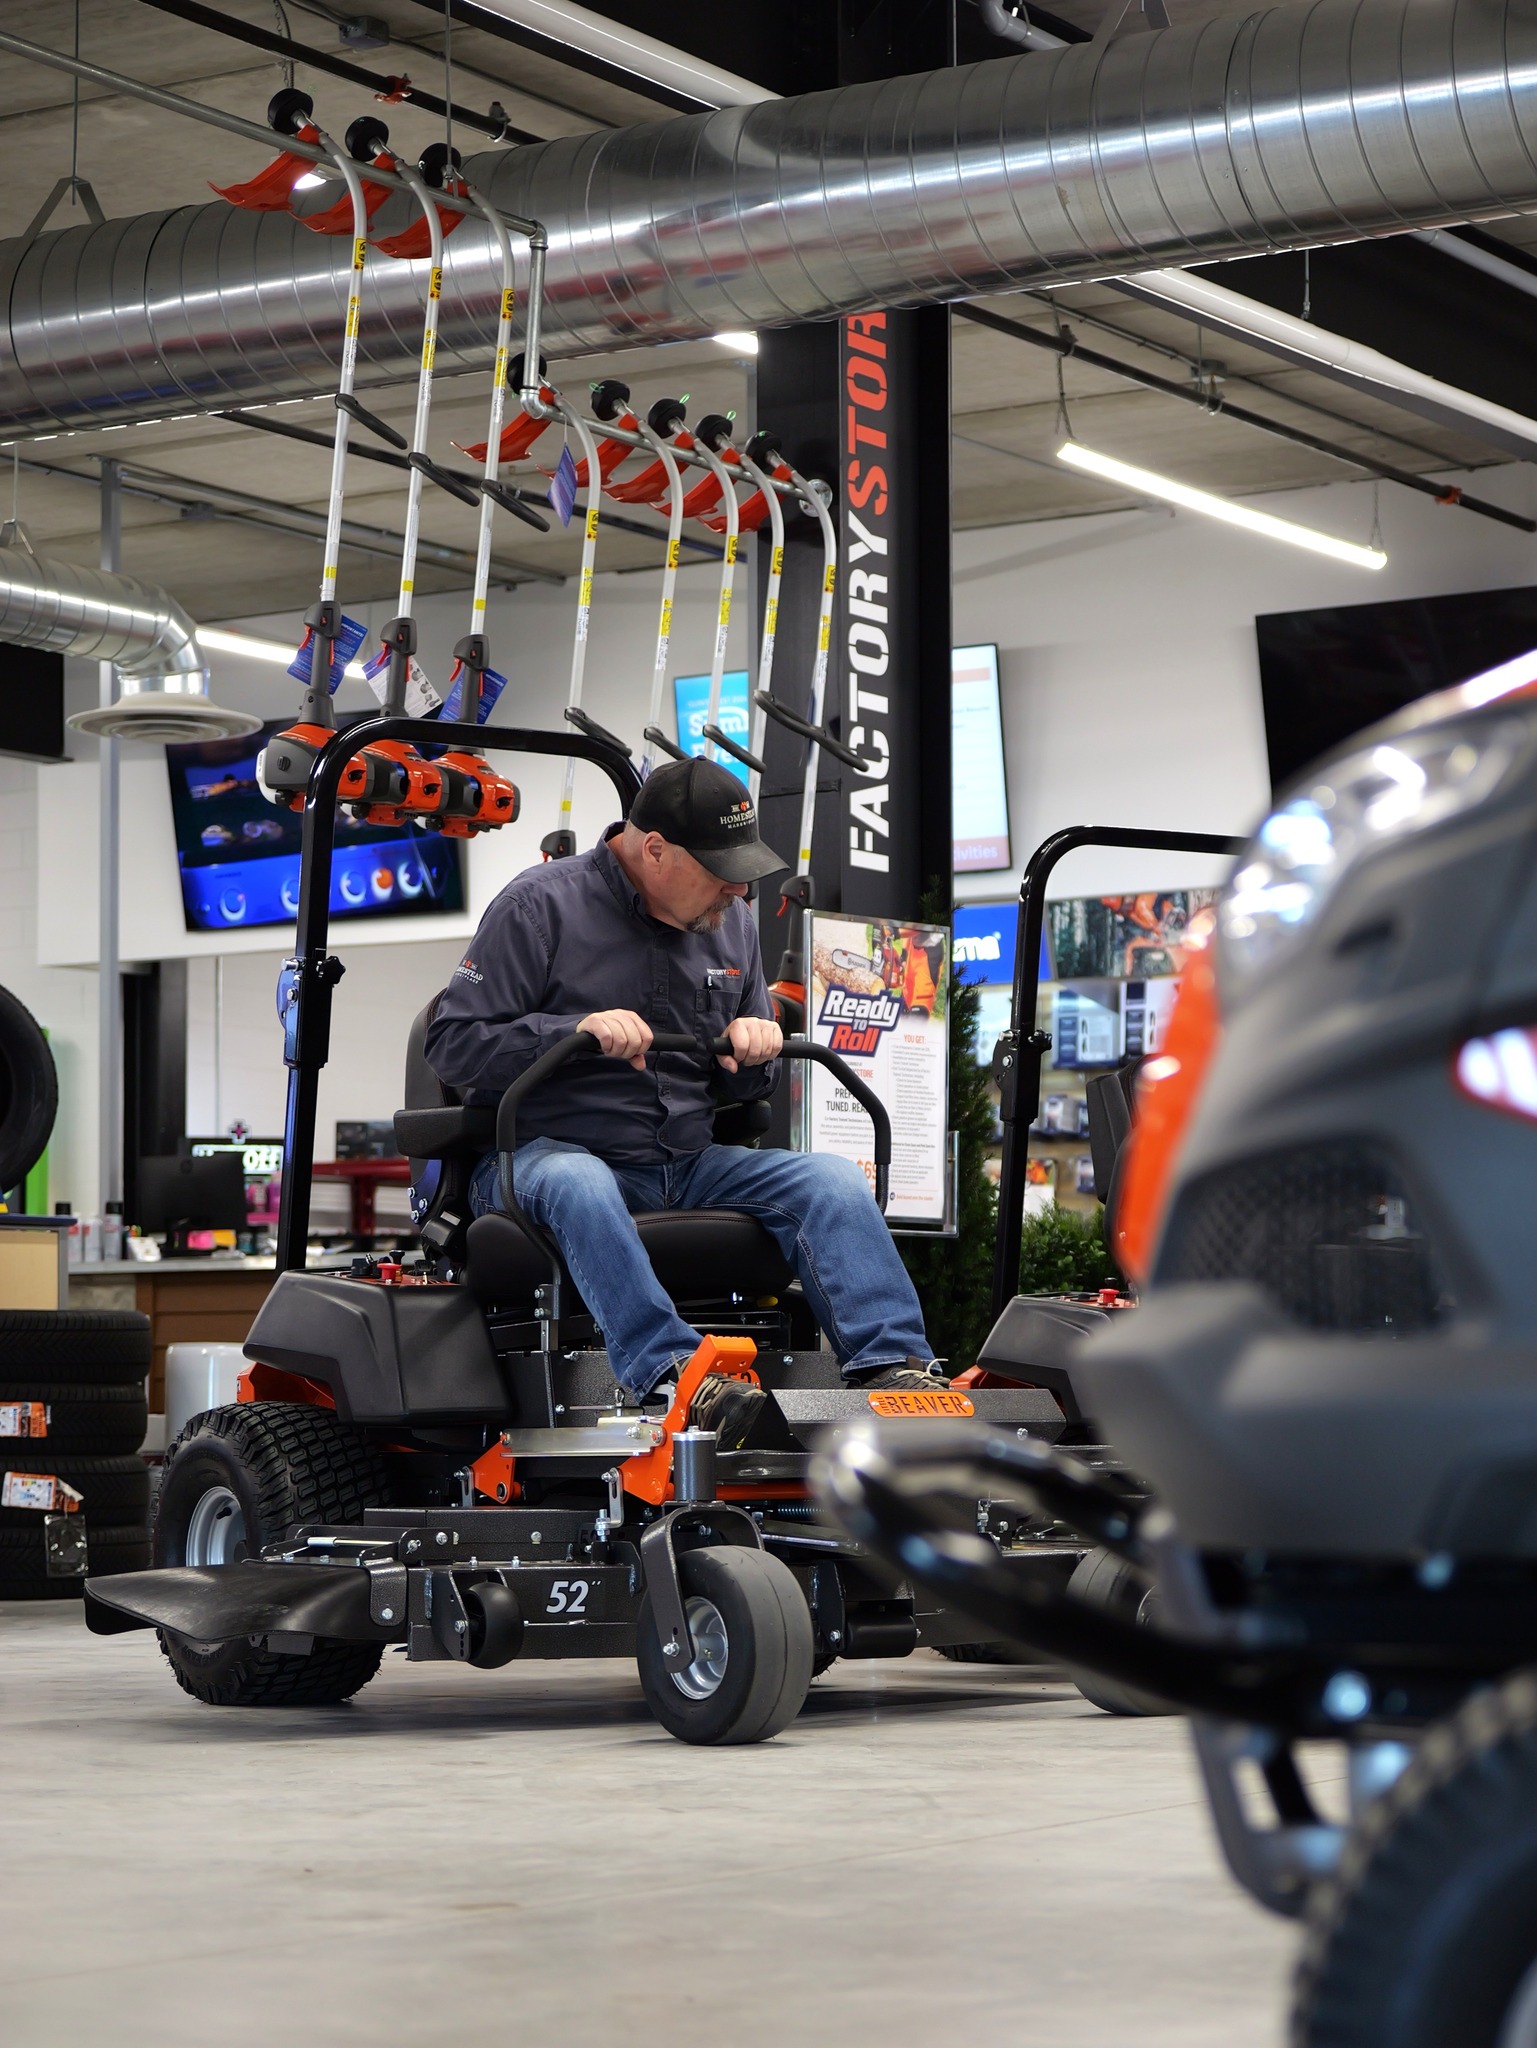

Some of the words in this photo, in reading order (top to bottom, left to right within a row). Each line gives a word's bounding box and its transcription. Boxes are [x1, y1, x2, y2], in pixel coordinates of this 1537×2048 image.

[823, 989, 900, 1028] Ready
[853, 1018, 868, 1031] TO
[831, 1024, 880, 1053] Roll
[903, 1034, 915, 1044] YOU
[826, 1100, 851, 1113] TUNED.
[884, 1395, 968, 1414] BEAVER
